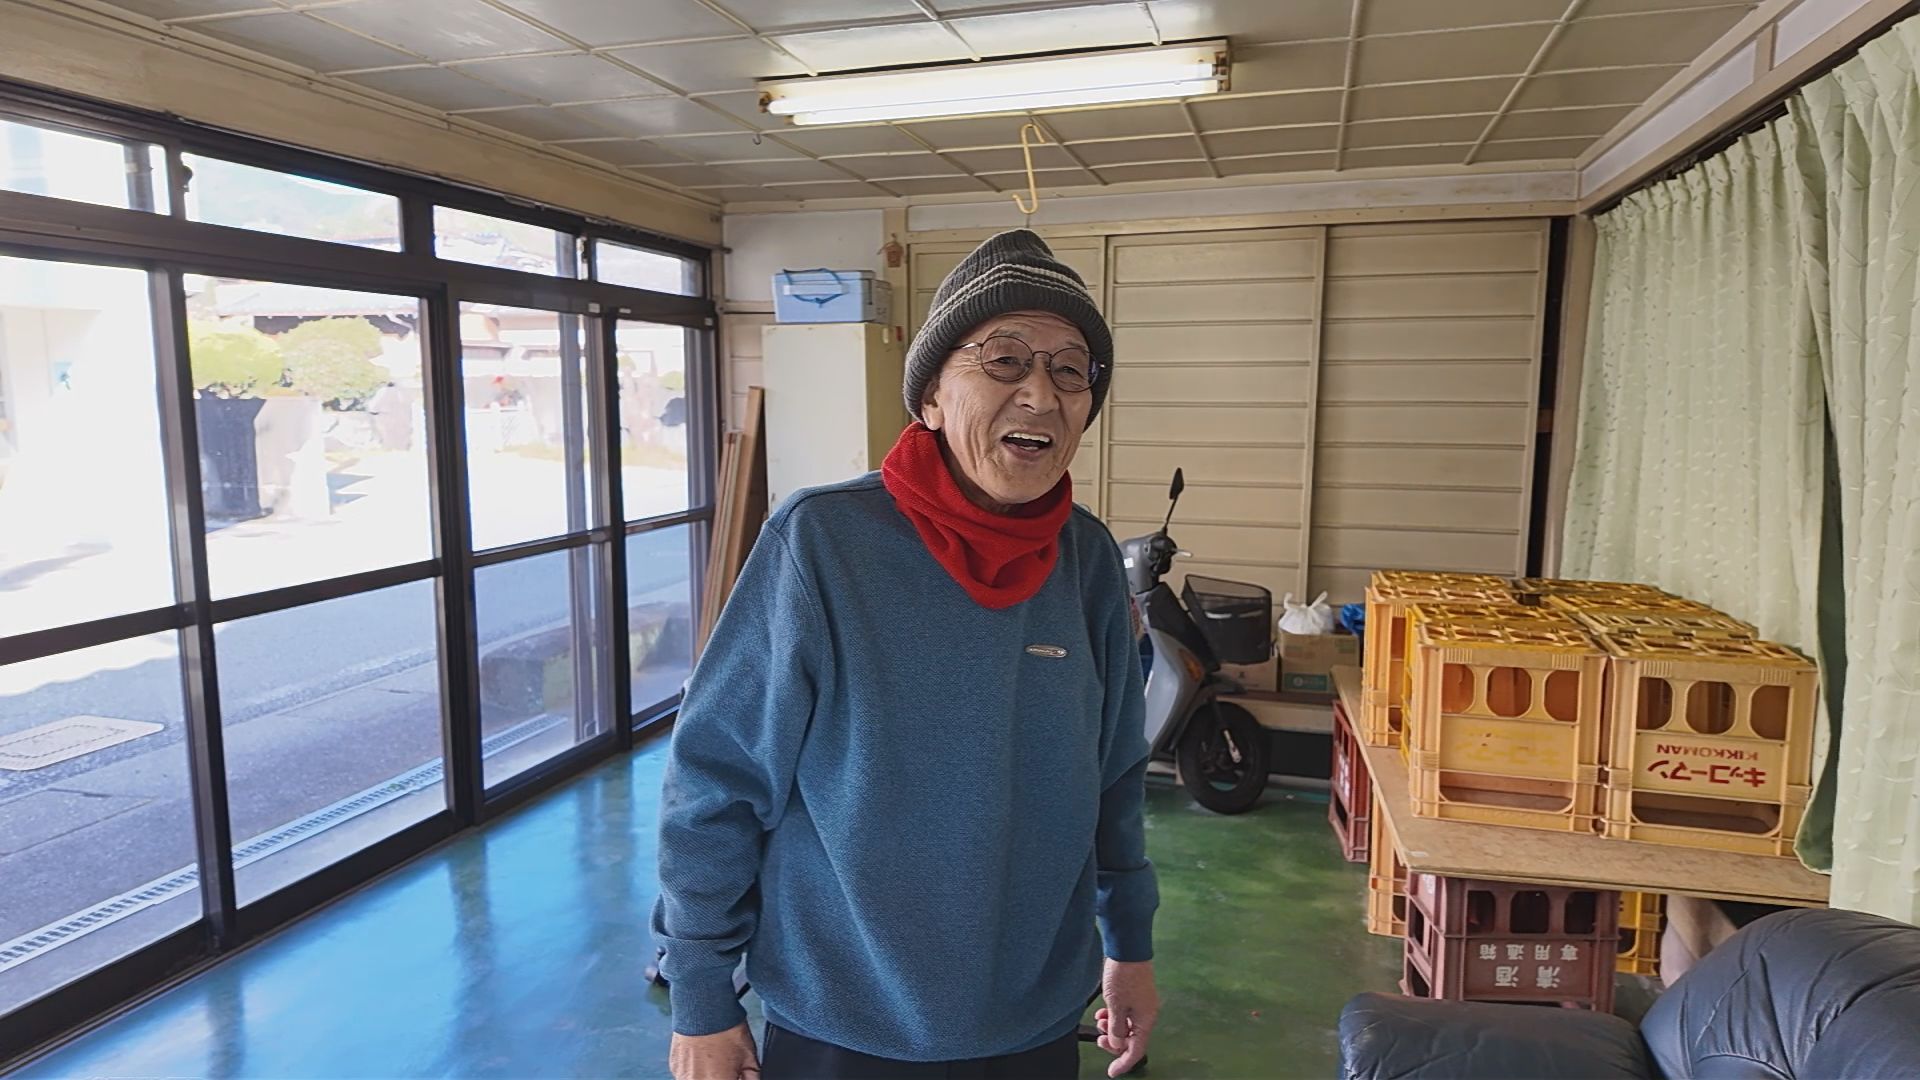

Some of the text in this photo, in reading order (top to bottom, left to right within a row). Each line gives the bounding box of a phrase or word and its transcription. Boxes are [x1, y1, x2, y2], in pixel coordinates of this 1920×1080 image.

[1656, 744, 1758, 761] KIKKOMAN
[1648, 760, 1766, 787] キッコーマン
[1495, 966, 1560, 988] 清酒
